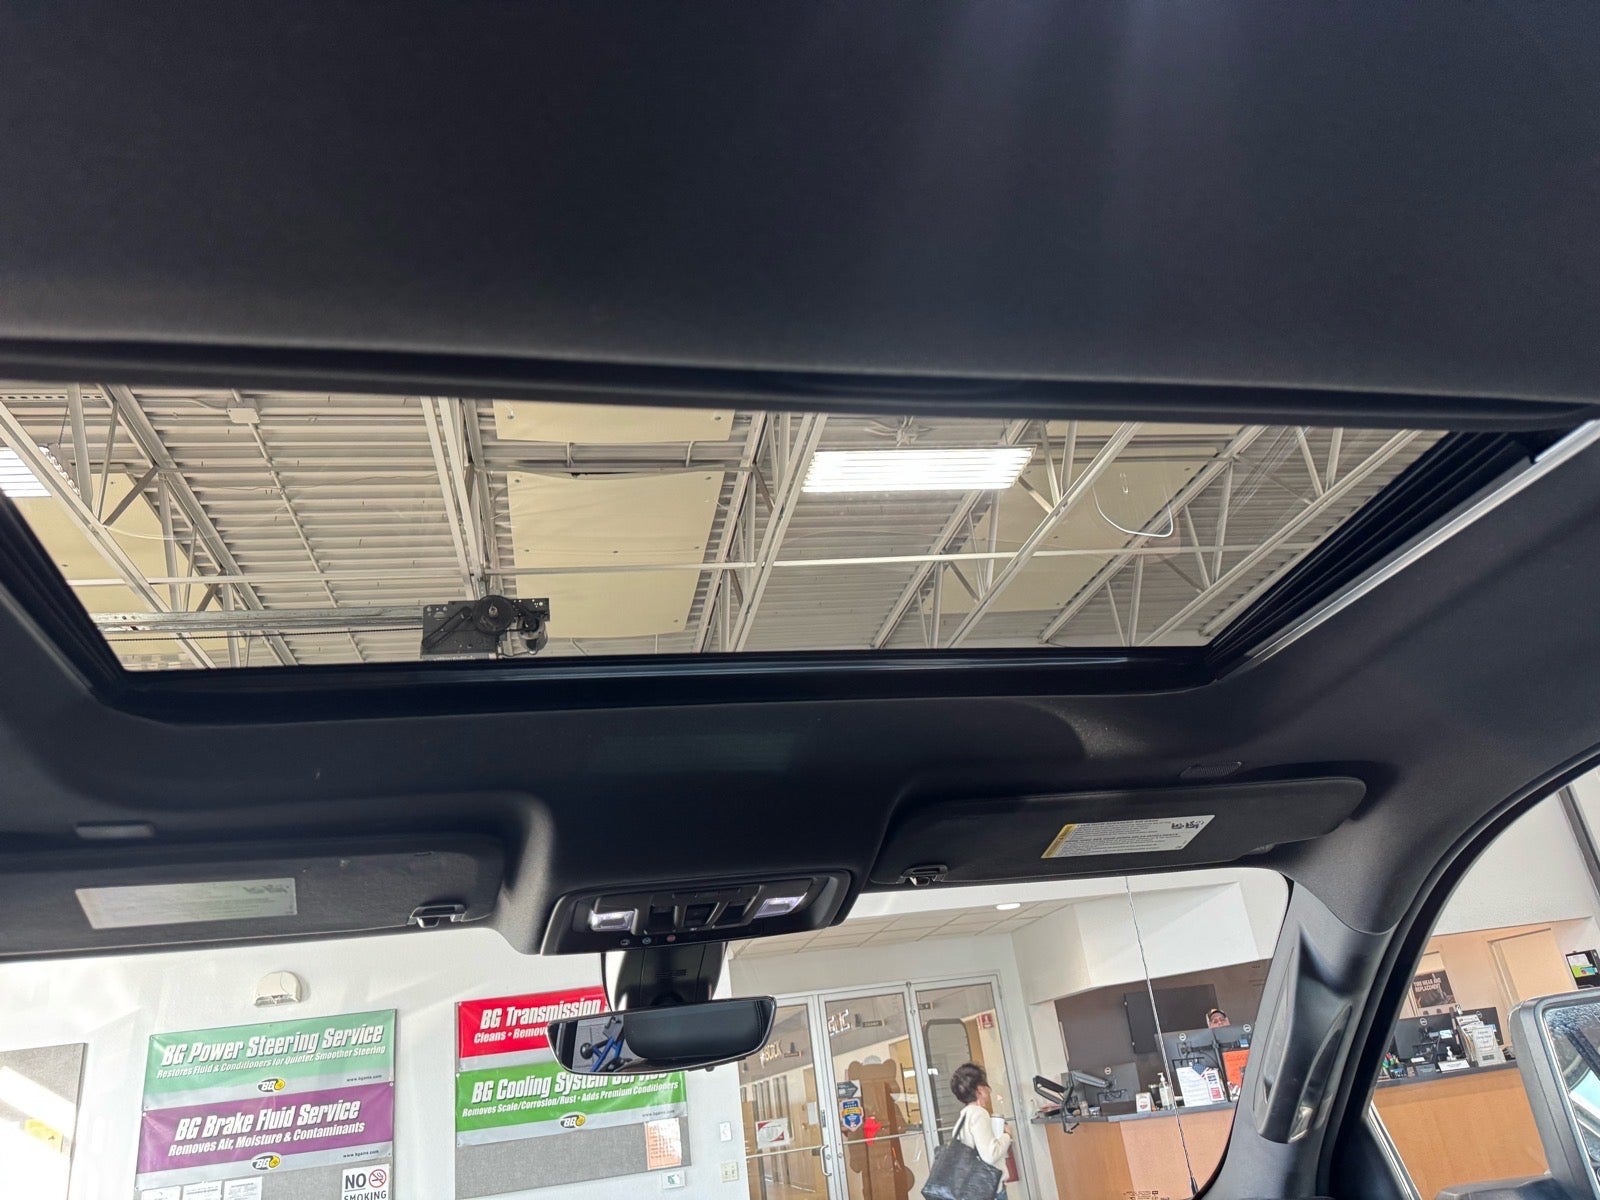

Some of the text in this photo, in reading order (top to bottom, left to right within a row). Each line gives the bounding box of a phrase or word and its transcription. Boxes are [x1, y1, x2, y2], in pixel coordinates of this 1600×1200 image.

[480, 1009, 502, 1030] BG
[506, 999, 601, 1027] Transmission
[161, 1024, 383, 1067] BG Power Steering Service
[474, 1027, 549, 1044] Cleans Remov
[157, 1067, 193, 1079] Restores
[193, 1064, 213, 1075] Fluid
[220, 1060, 270, 1073] Conditioners
[272, 1057, 285, 1067] for
[315, 1049, 352, 1061] Smoother
[353, 1045, 386, 1057] Steering
[462, 1081, 679, 1118] Removes Scale/Corrosion/Rust Adds Premium Conditioners
[471, 1081, 494, 1104] BG
[496, 1075, 552, 1100] Cooling
[554, 1072, 608, 1096] System
[174, 1100, 361, 1141] BG Brake Fluid Service
[168, 1122, 365, 1156] Removes Air, Moisture & Contaminants
[344, 1190, 387, 1200] SMOKING
[345, 1173, 367, 1190] NO
